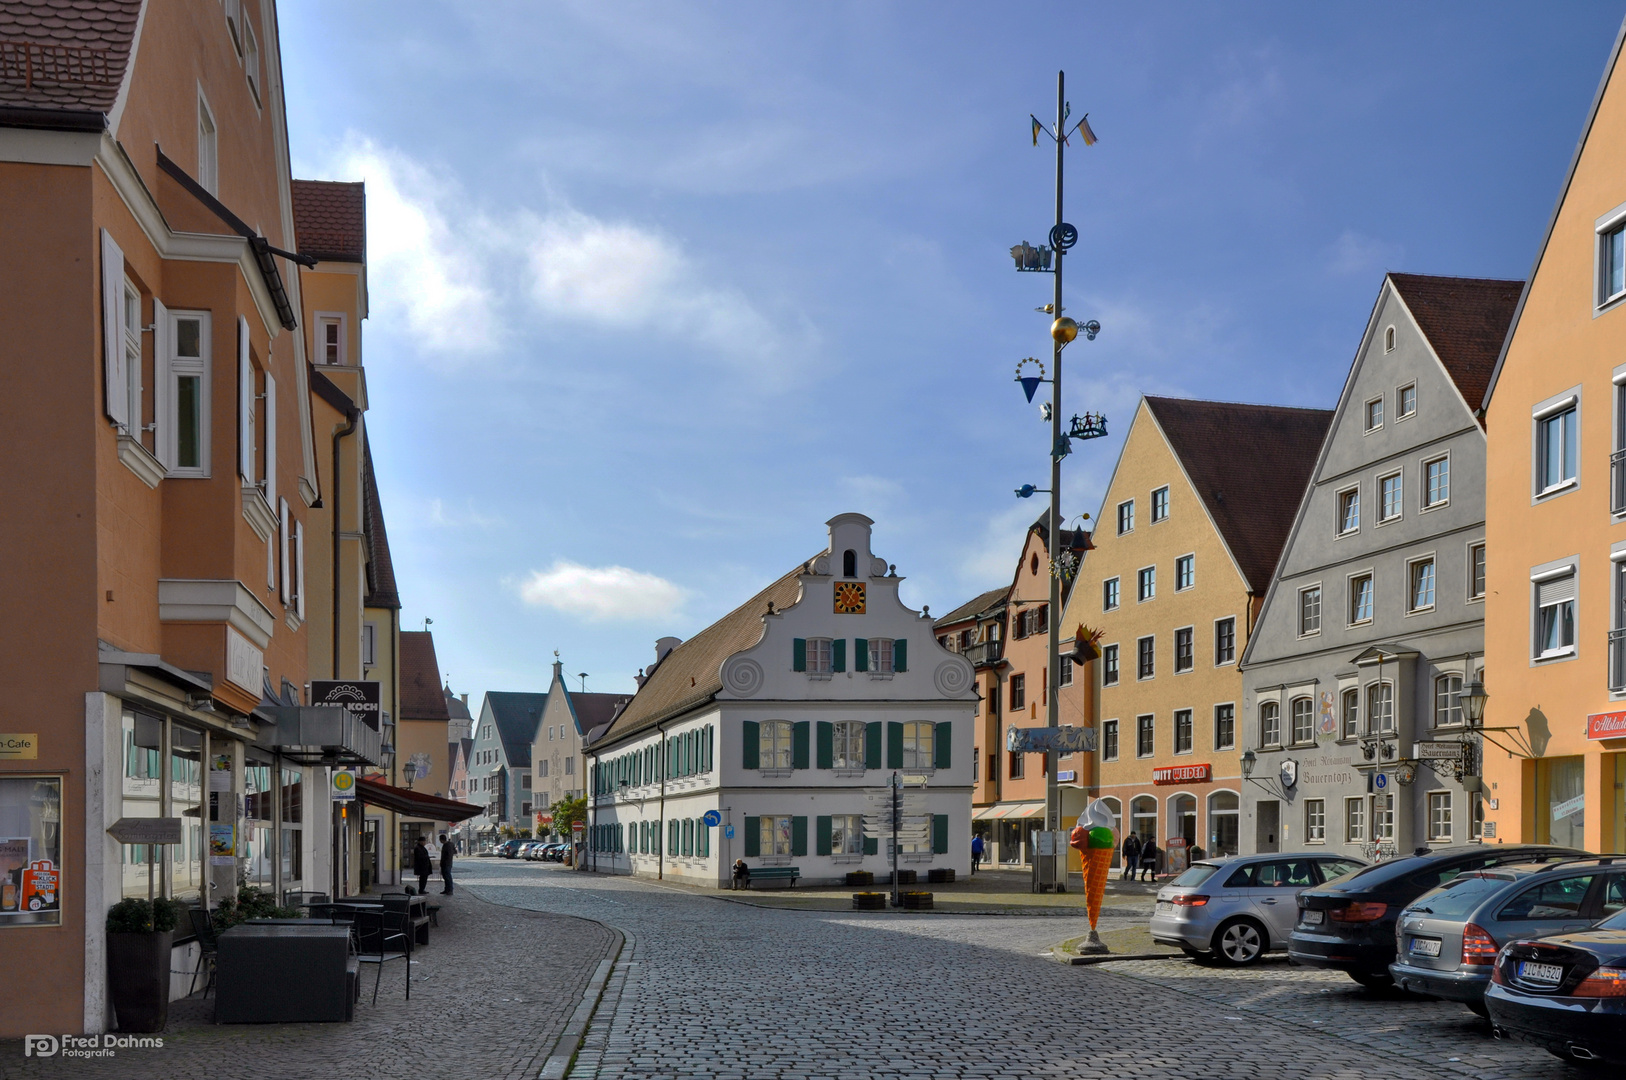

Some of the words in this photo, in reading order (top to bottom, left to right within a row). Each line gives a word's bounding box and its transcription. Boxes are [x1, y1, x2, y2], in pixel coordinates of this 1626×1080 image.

[347, 703, 378, 711] KOCH
[1421, 749, 1460, 757] Bauerntanz
[1153, 769, 1171, 780] WITT
[1173, 767, 1206, 779] WEIDEN
[1302, 771, 1352, 784] Bauerntanz
[118, 829, 177, 841] Sommergarten
[1523, 963, 1537, 976] AIC
